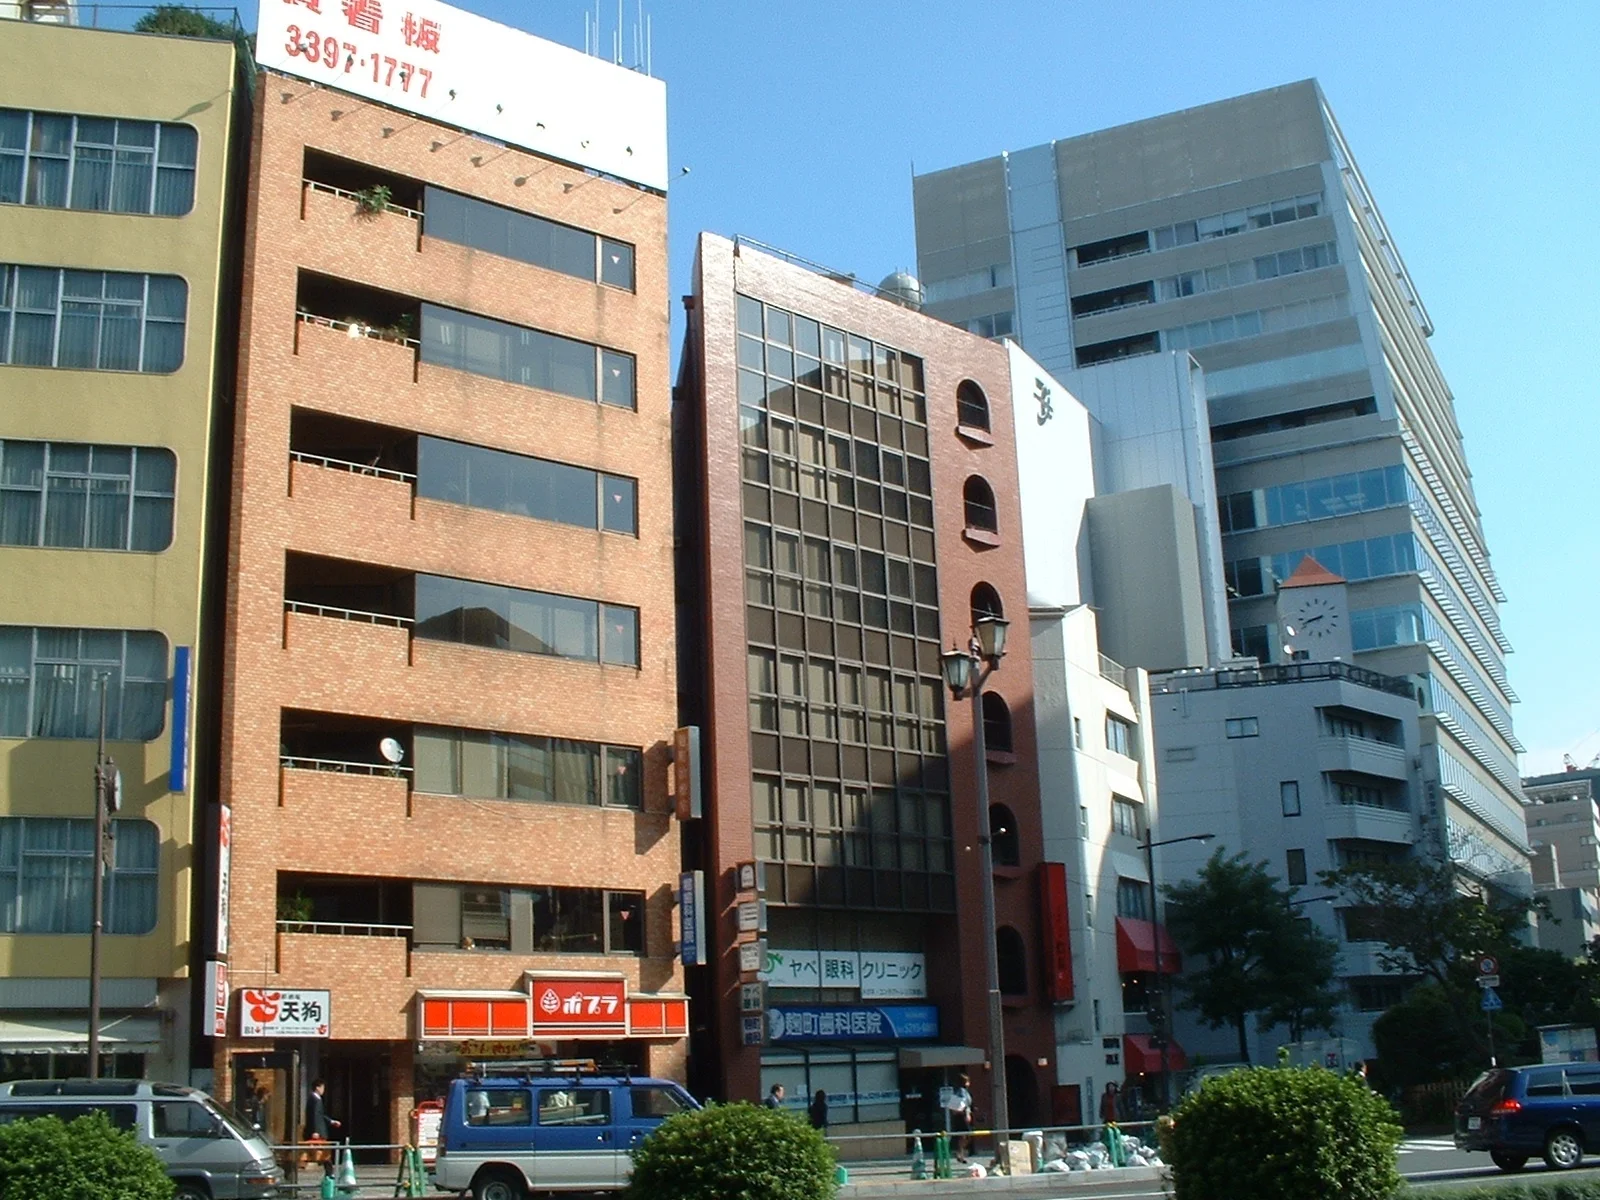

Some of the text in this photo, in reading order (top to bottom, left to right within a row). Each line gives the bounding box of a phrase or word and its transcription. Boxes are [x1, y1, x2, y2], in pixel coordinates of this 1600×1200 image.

[278, 1000, 322, 1023] 天狗
[562, 991, 618, 1015] ポプラ
